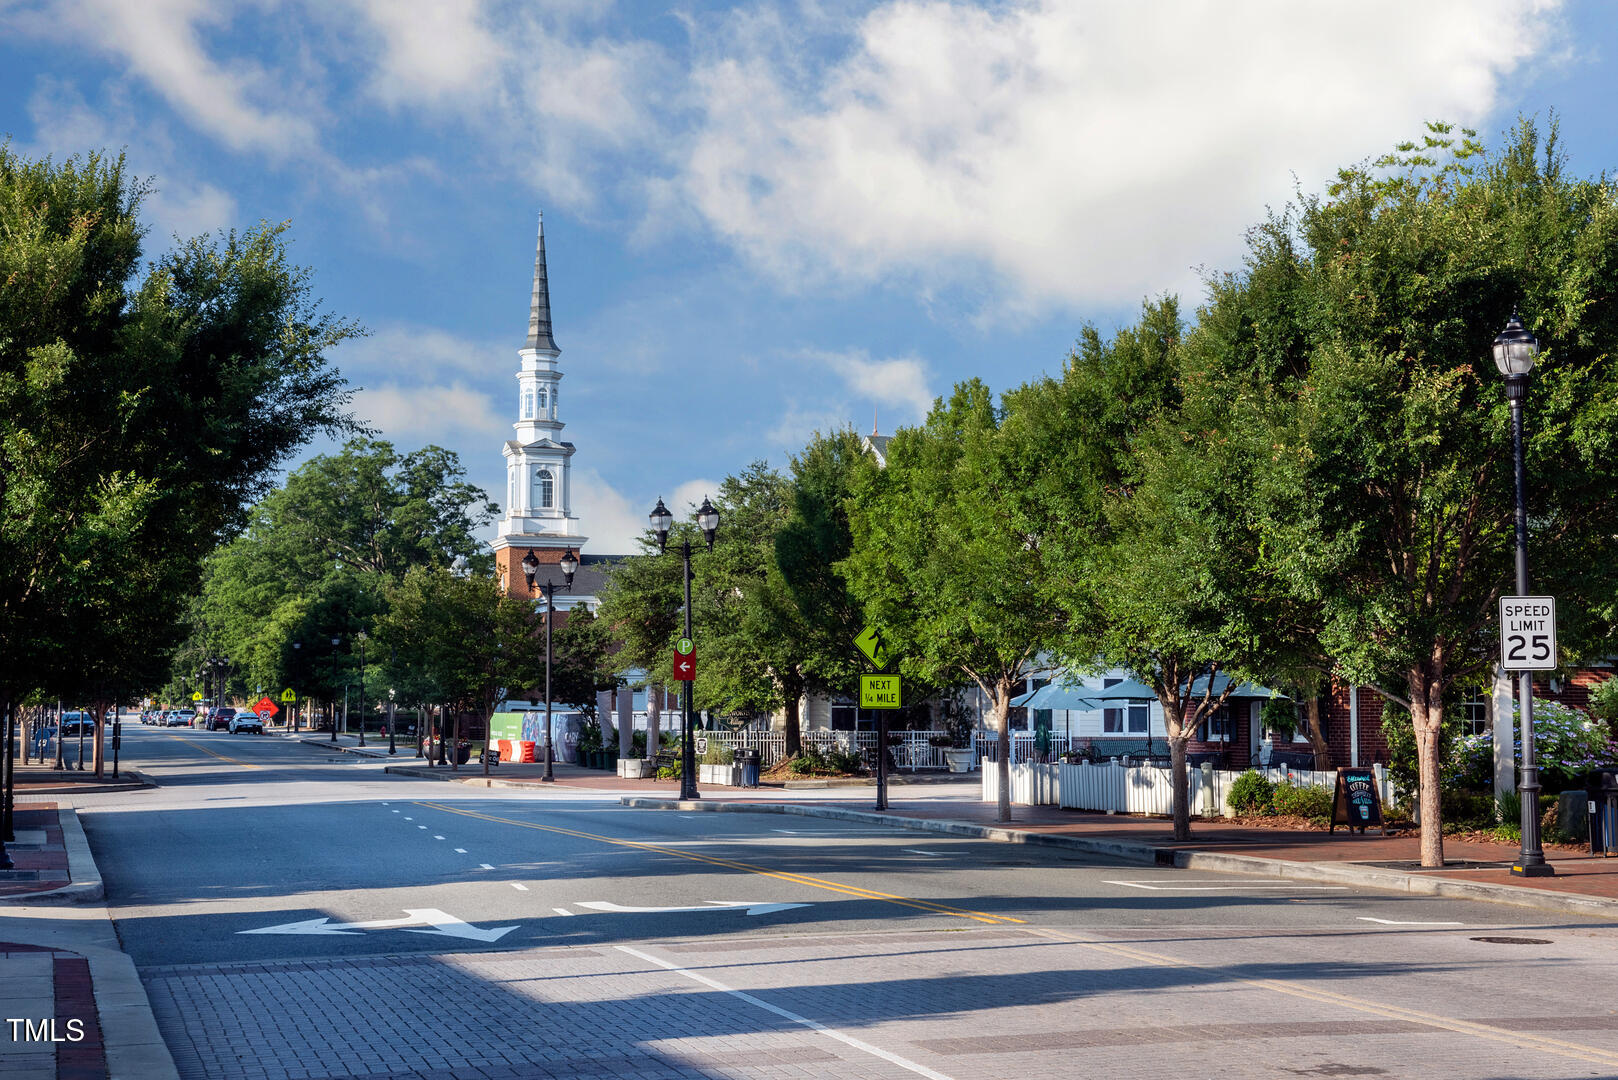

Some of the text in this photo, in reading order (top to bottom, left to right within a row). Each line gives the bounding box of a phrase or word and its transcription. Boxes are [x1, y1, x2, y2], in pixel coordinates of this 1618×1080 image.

[1505, 605, 1550, 617] SPEED
[1510, 620, 1545, 632] LIMIT
[682, 640, 690, 653] P
[1507, 634, 1550, 661] 25
[869, 680, 891, 690] NEXT
[876, 693, 897, 703] MILE
